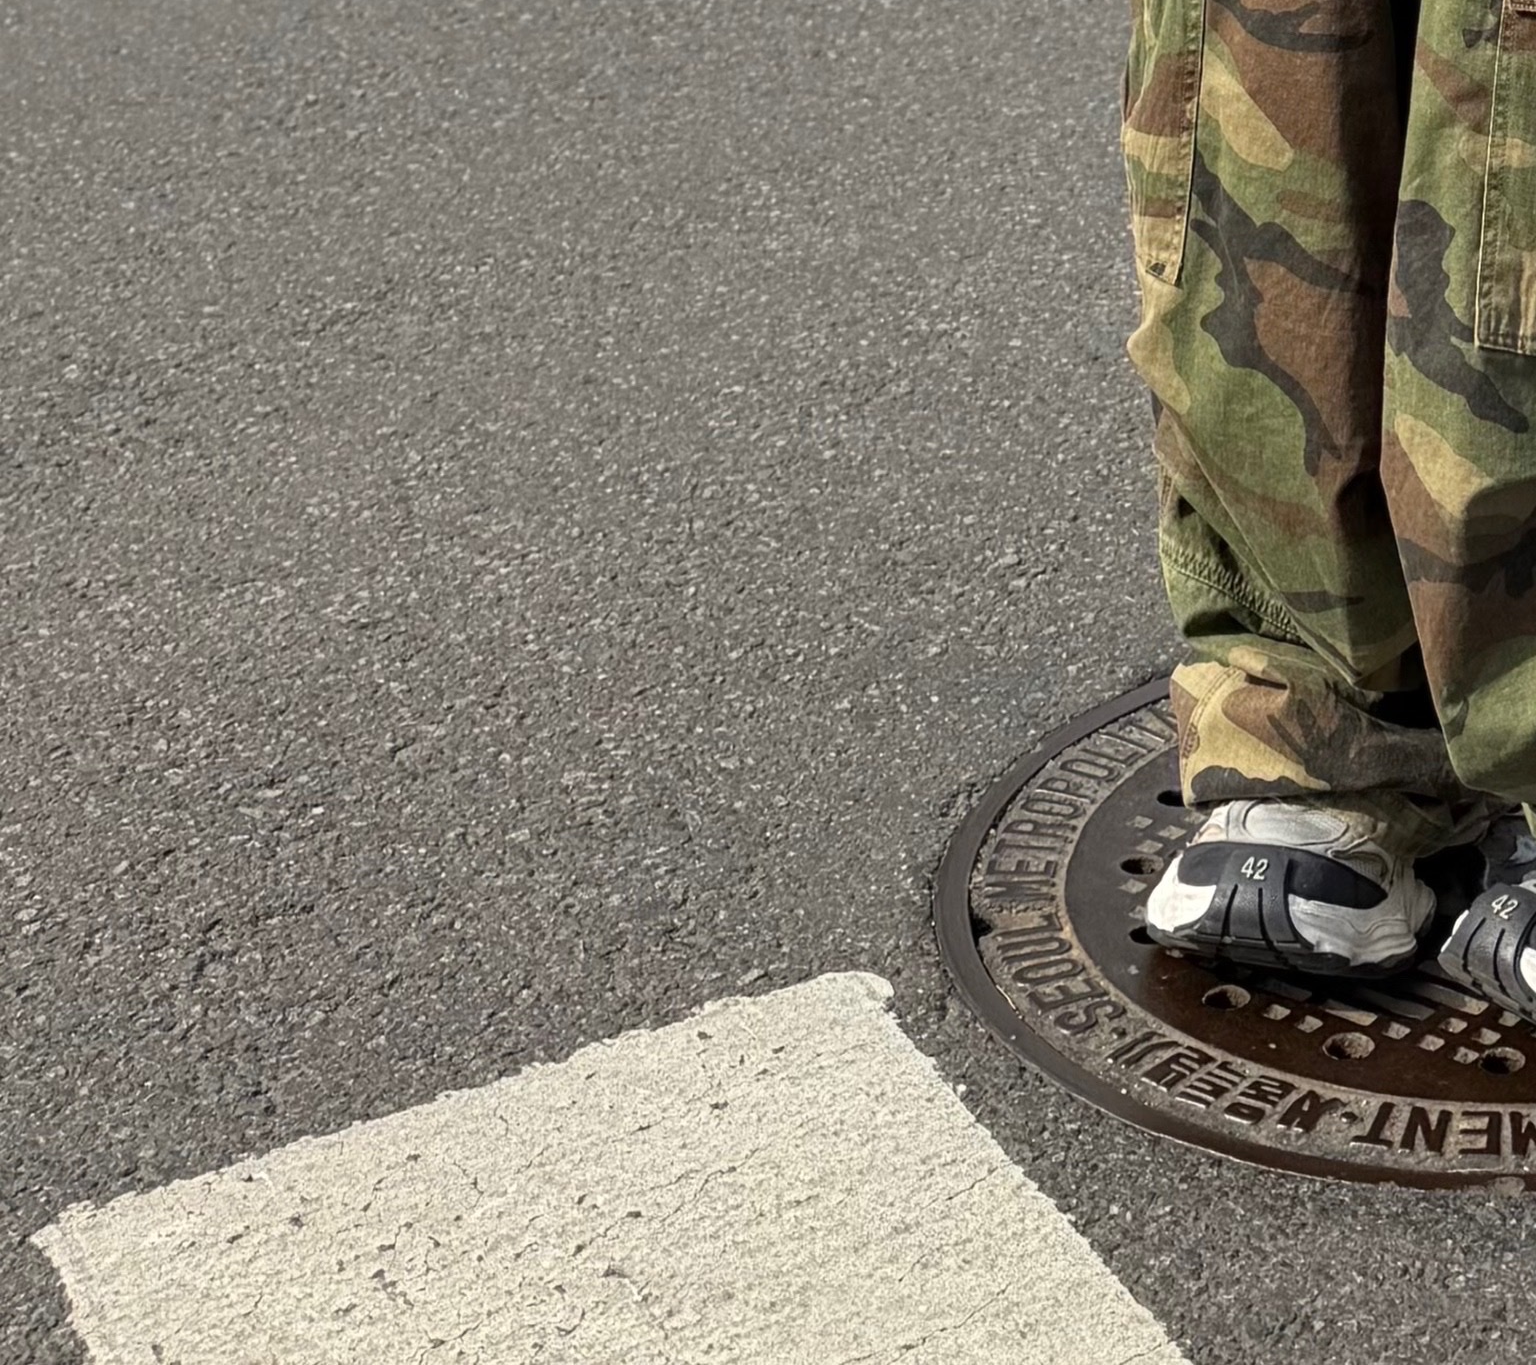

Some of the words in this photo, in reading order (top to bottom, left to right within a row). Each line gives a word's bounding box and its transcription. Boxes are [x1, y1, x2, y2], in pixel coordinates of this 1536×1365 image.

[1240, 856, 1268, 881] 42
[1491, 893, 1519, 920] 42
[992, 912, 1126, 1037] SEOUL
[1103, 1030, 1347, 1132] 서울특별시
